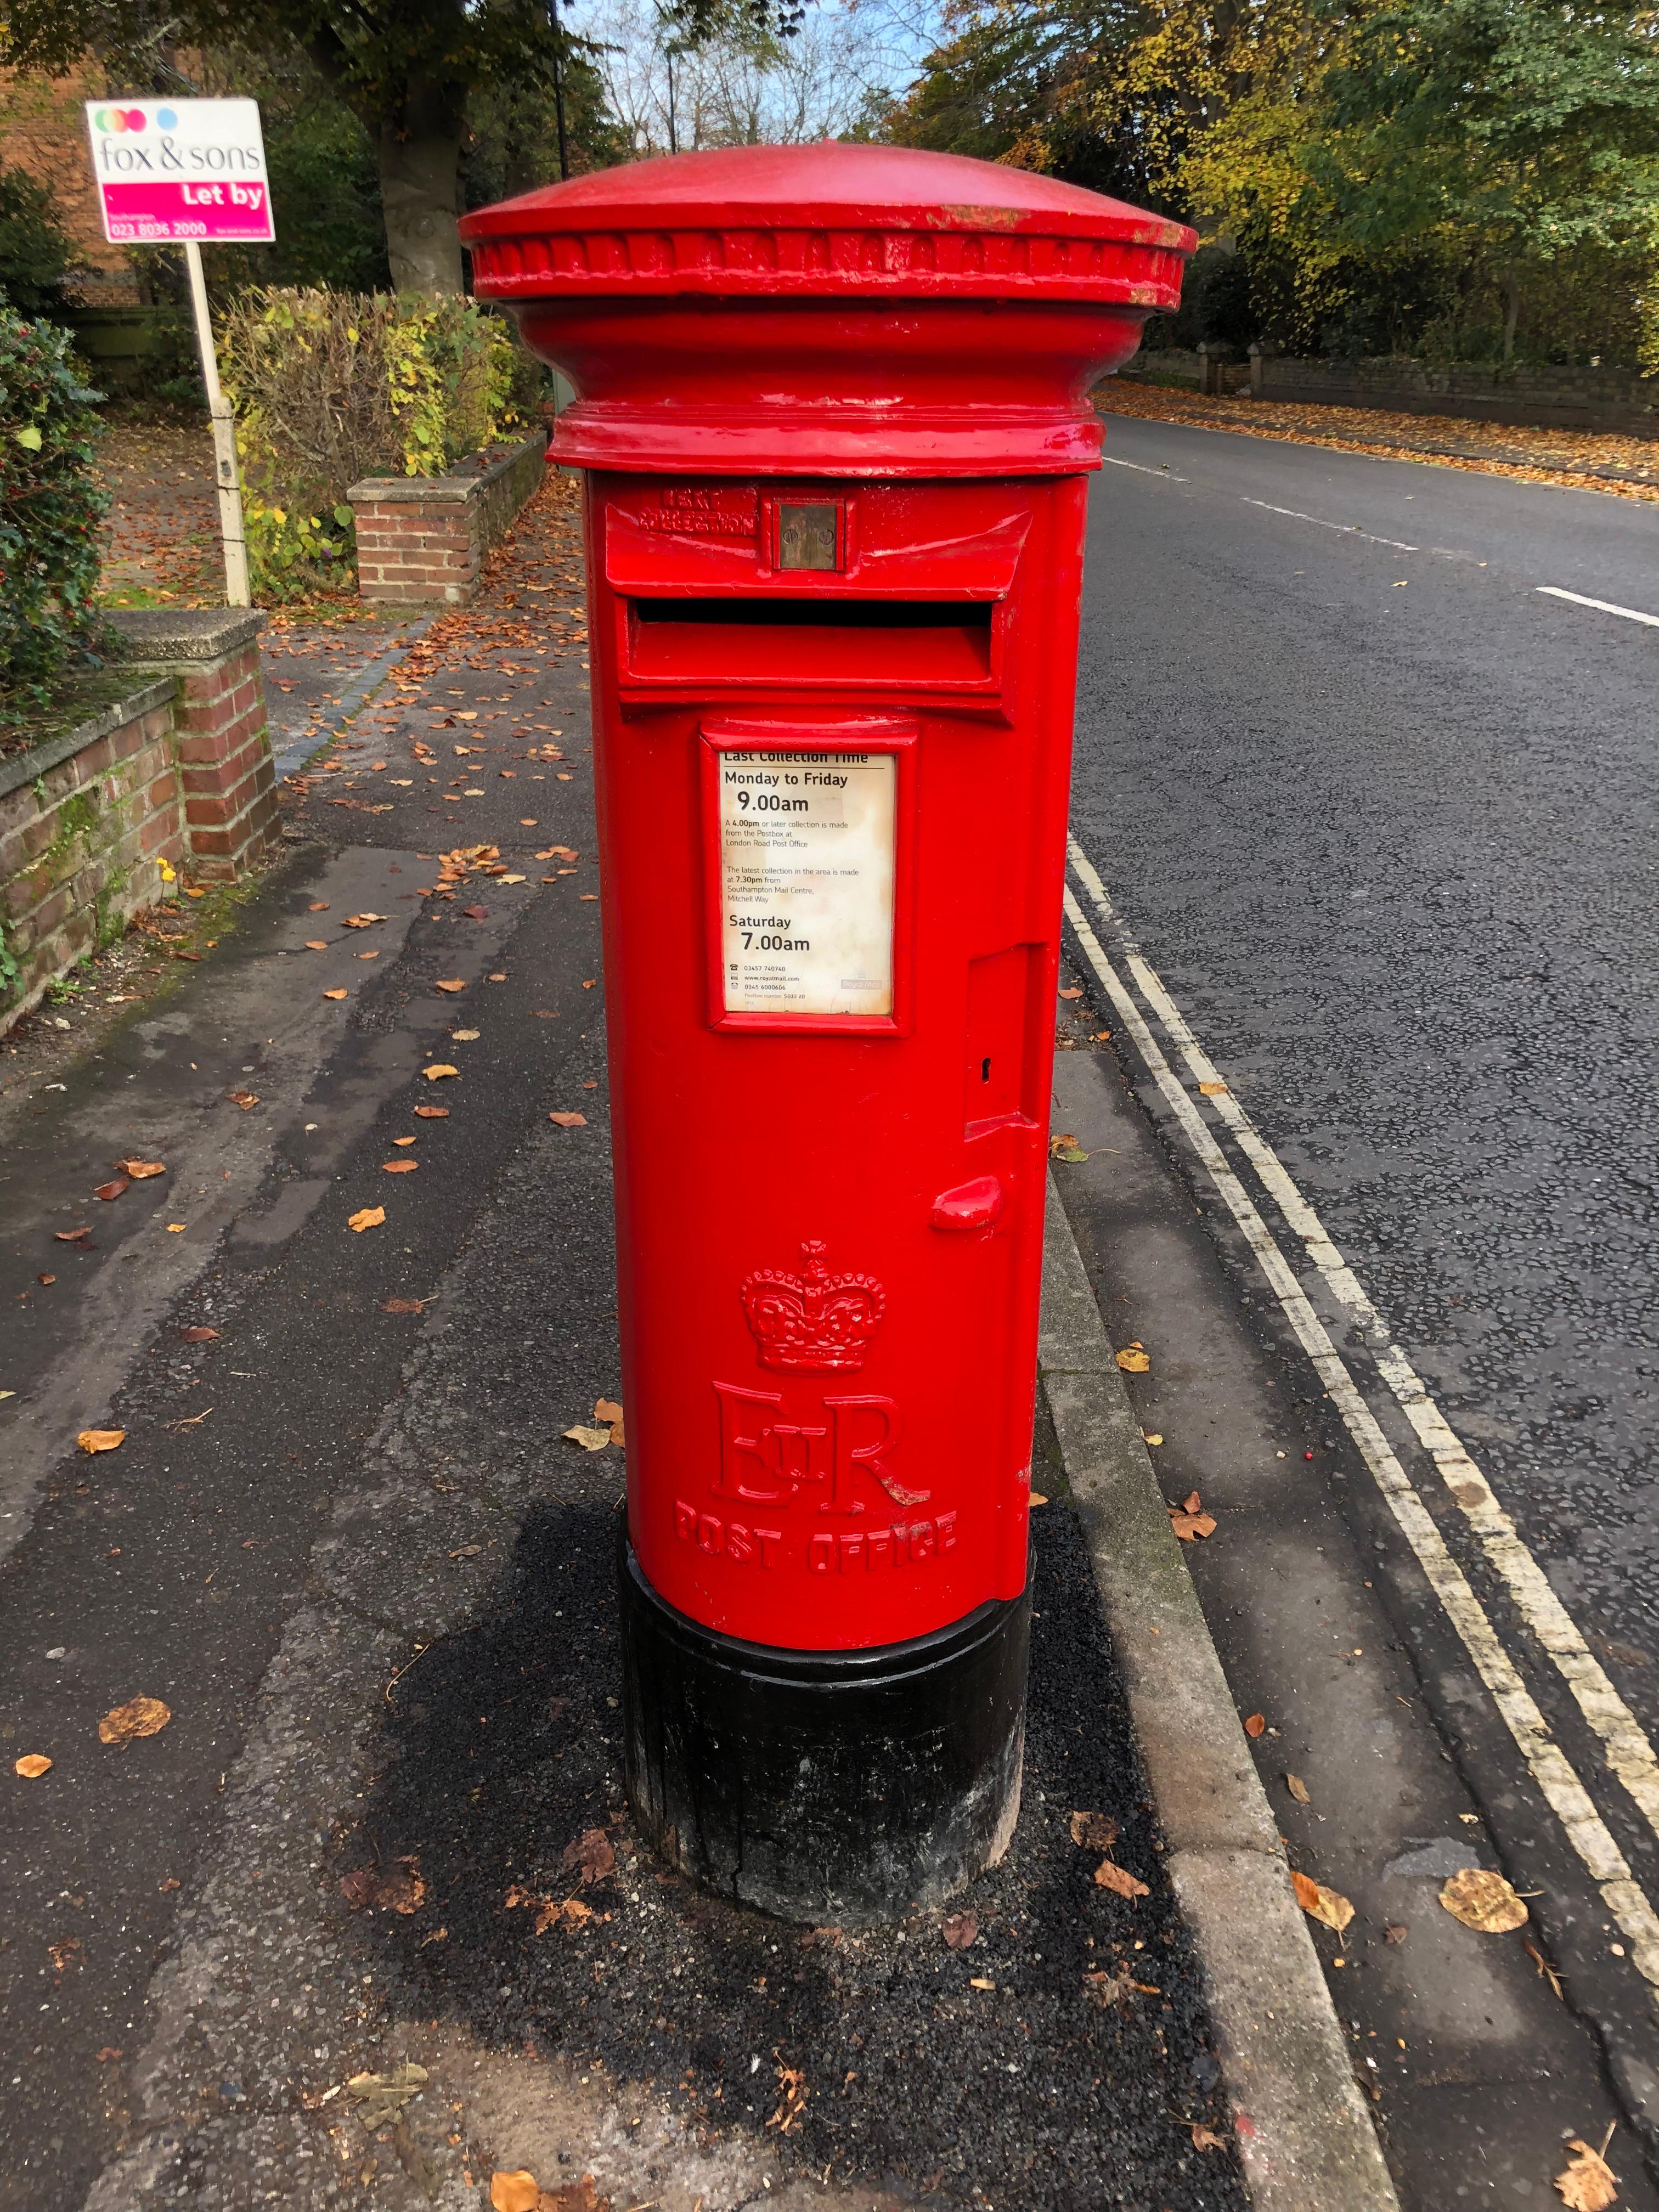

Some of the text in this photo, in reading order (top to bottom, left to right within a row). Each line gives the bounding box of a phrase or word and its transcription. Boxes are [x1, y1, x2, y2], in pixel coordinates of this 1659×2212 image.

[99, 136, 261, 171] fox & sons
[183, 183, 263, 210] Let by
[111, 222, 206, 236] 023 8036 2000
[725, 771, 848, 788] Monday to Friday
[737, 791, 809, 811] 9.00am
[732, 820, 760, 828] 4.00pm
[789, 840, 808, 848] Office
[736, 876, 763, 884] 7.30pm
[727, 885, 773, 894] Southampton
[791, 887, 814, 895] Centre,
[754, 896, 769, 904] Way
[730, 915, 791, 929] Saturday
[741, 932, 810, 951] 7.00am
[676, 1499, 957, 1573] POST OFFICE
